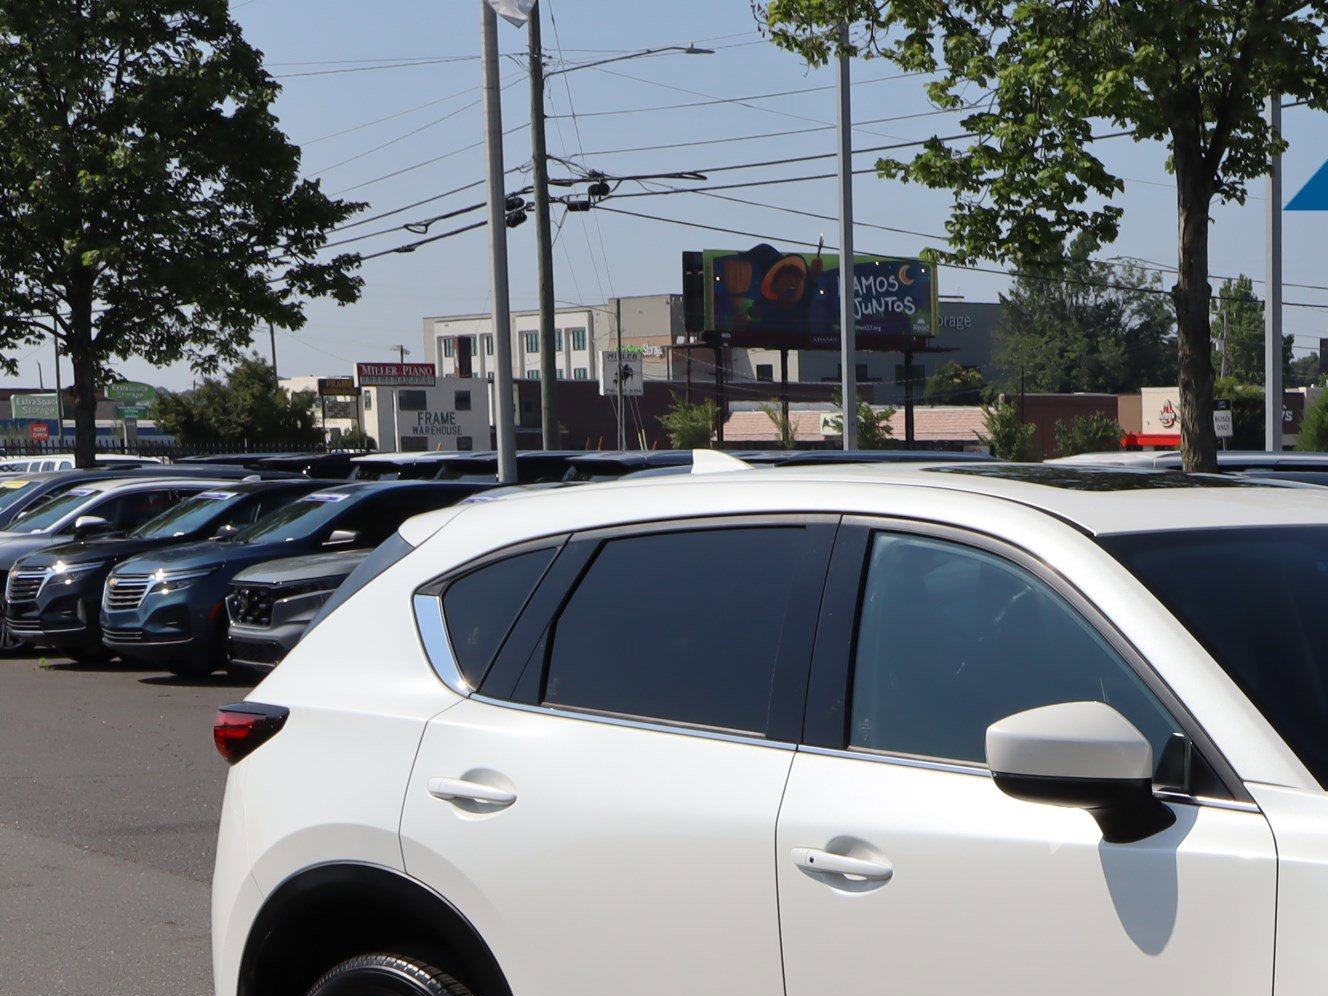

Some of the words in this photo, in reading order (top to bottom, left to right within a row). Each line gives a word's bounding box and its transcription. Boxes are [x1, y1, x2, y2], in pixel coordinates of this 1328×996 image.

[837, 275, 899, 297] AMOS
[402, 366, 433, 376] PIANO
[417, 412, 456, 425] FRAME
[412, 426, 462, 436] WAREHOUSE
